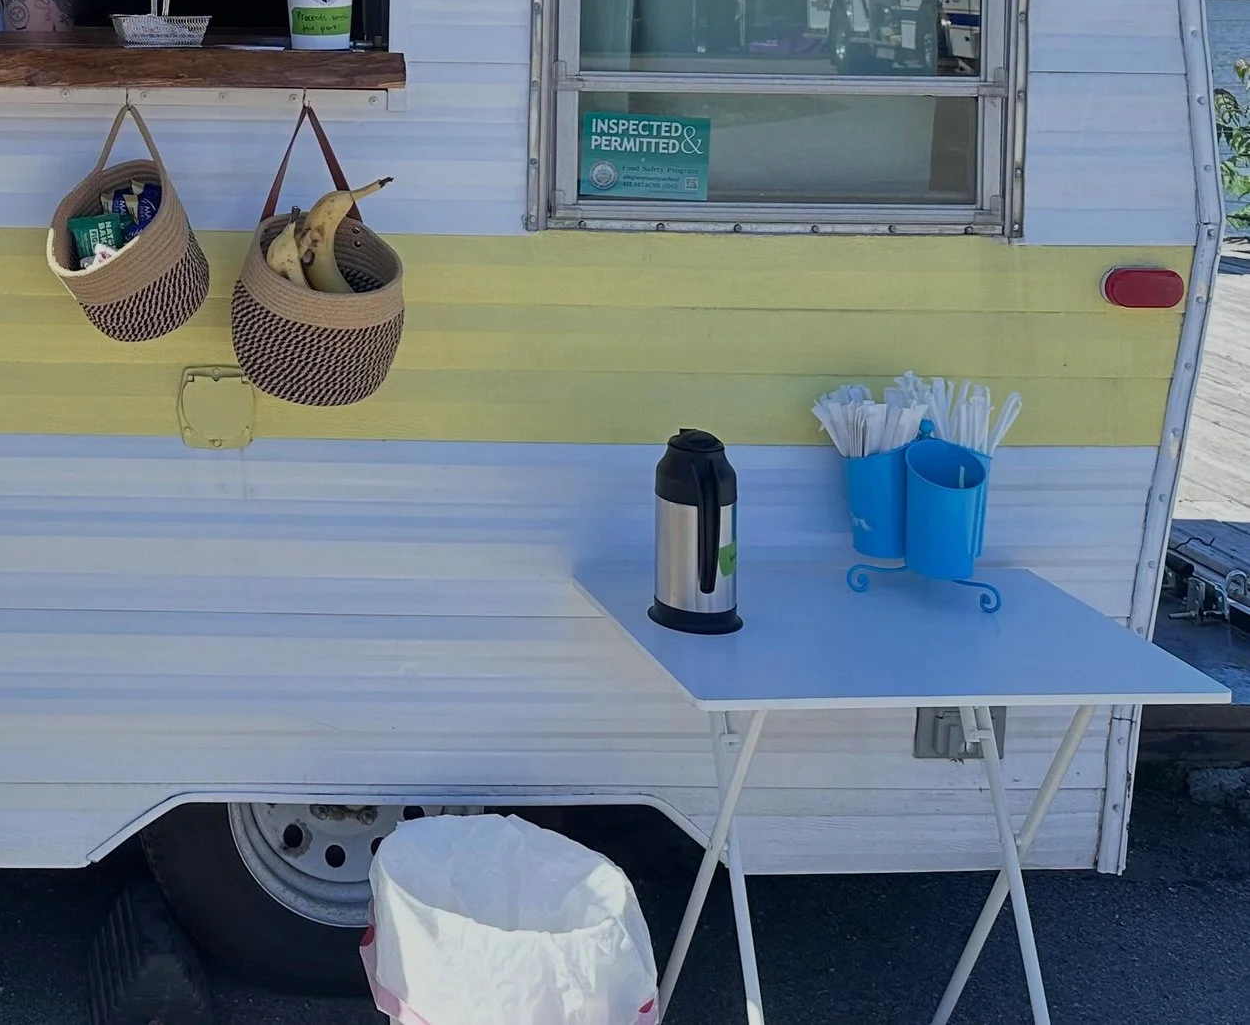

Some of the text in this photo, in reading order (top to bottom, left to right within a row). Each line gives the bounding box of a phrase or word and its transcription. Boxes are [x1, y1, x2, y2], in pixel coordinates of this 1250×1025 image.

[590, 135, 680, 154] PERMITTED
[591, 118, 704, 155] INSPECTED &
[642, 165, 664, 174] Safety
[667, 166, 699, 175] Program
